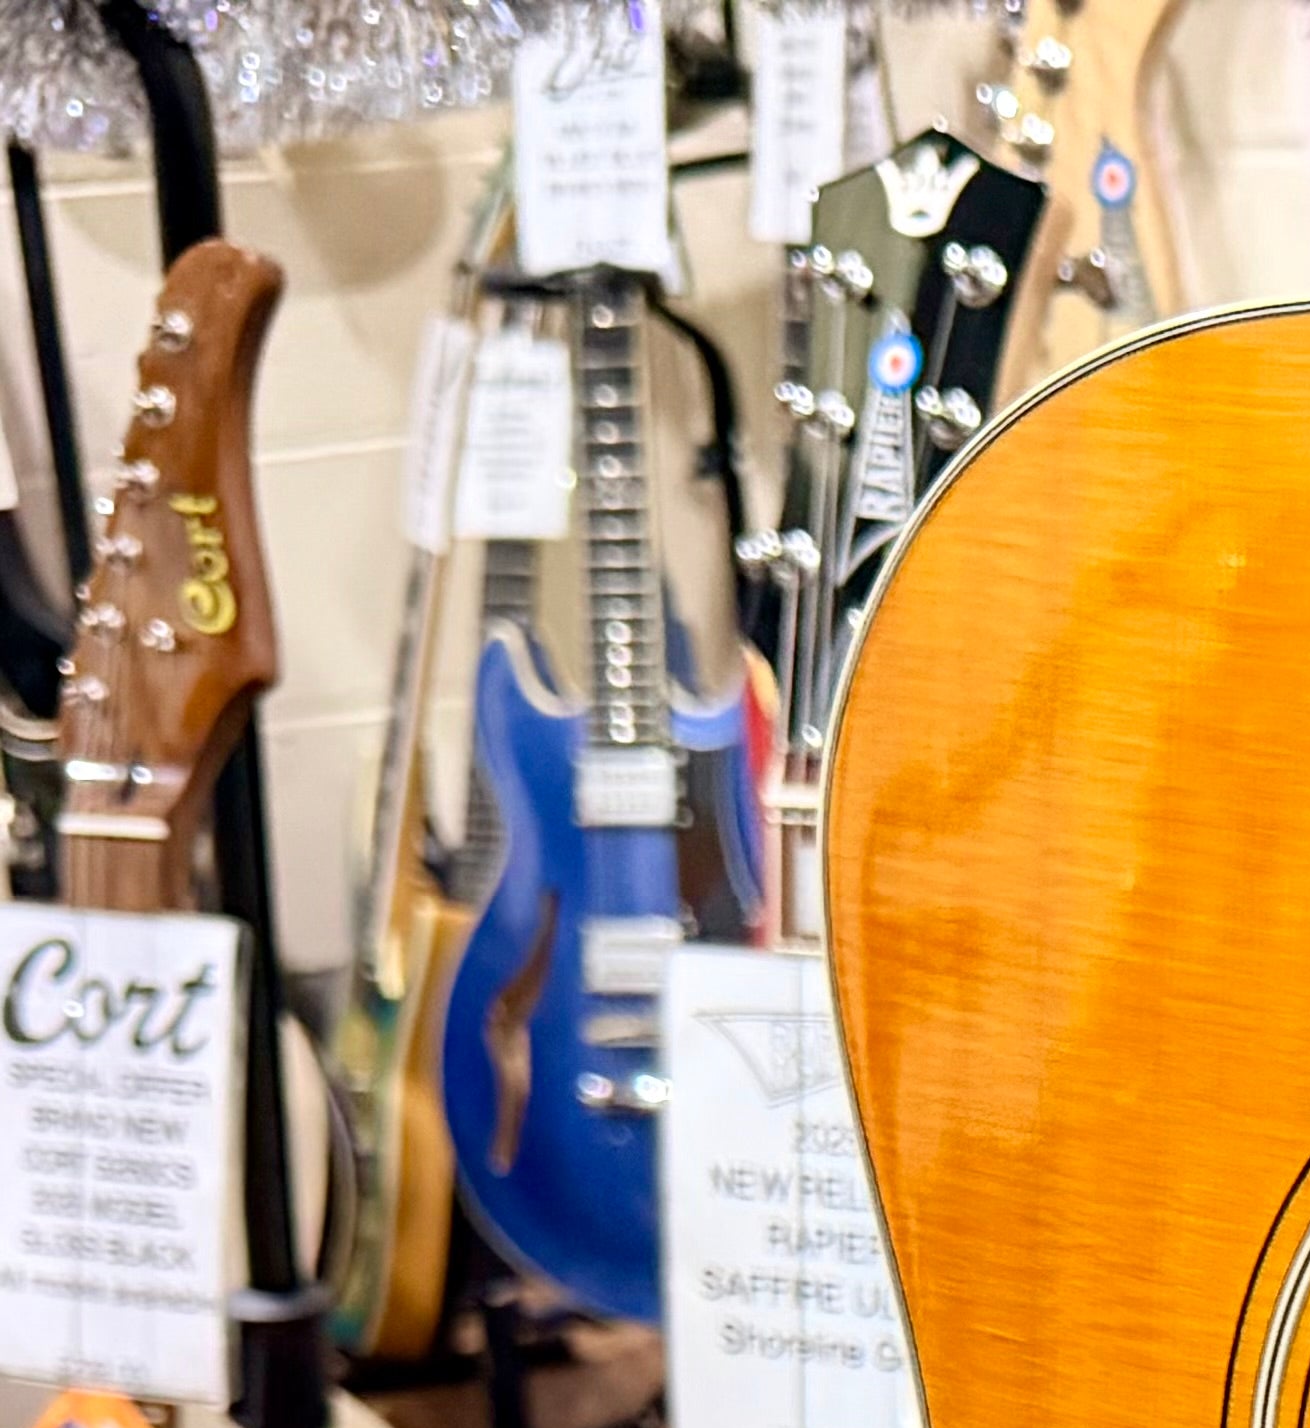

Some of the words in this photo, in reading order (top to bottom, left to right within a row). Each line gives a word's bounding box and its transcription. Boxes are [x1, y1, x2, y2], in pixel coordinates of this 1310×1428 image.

[168, 494, 237, 634] Cort
[3, 938, 217, 1056] Cort
[123, 1111, 189, 1145] NEW
